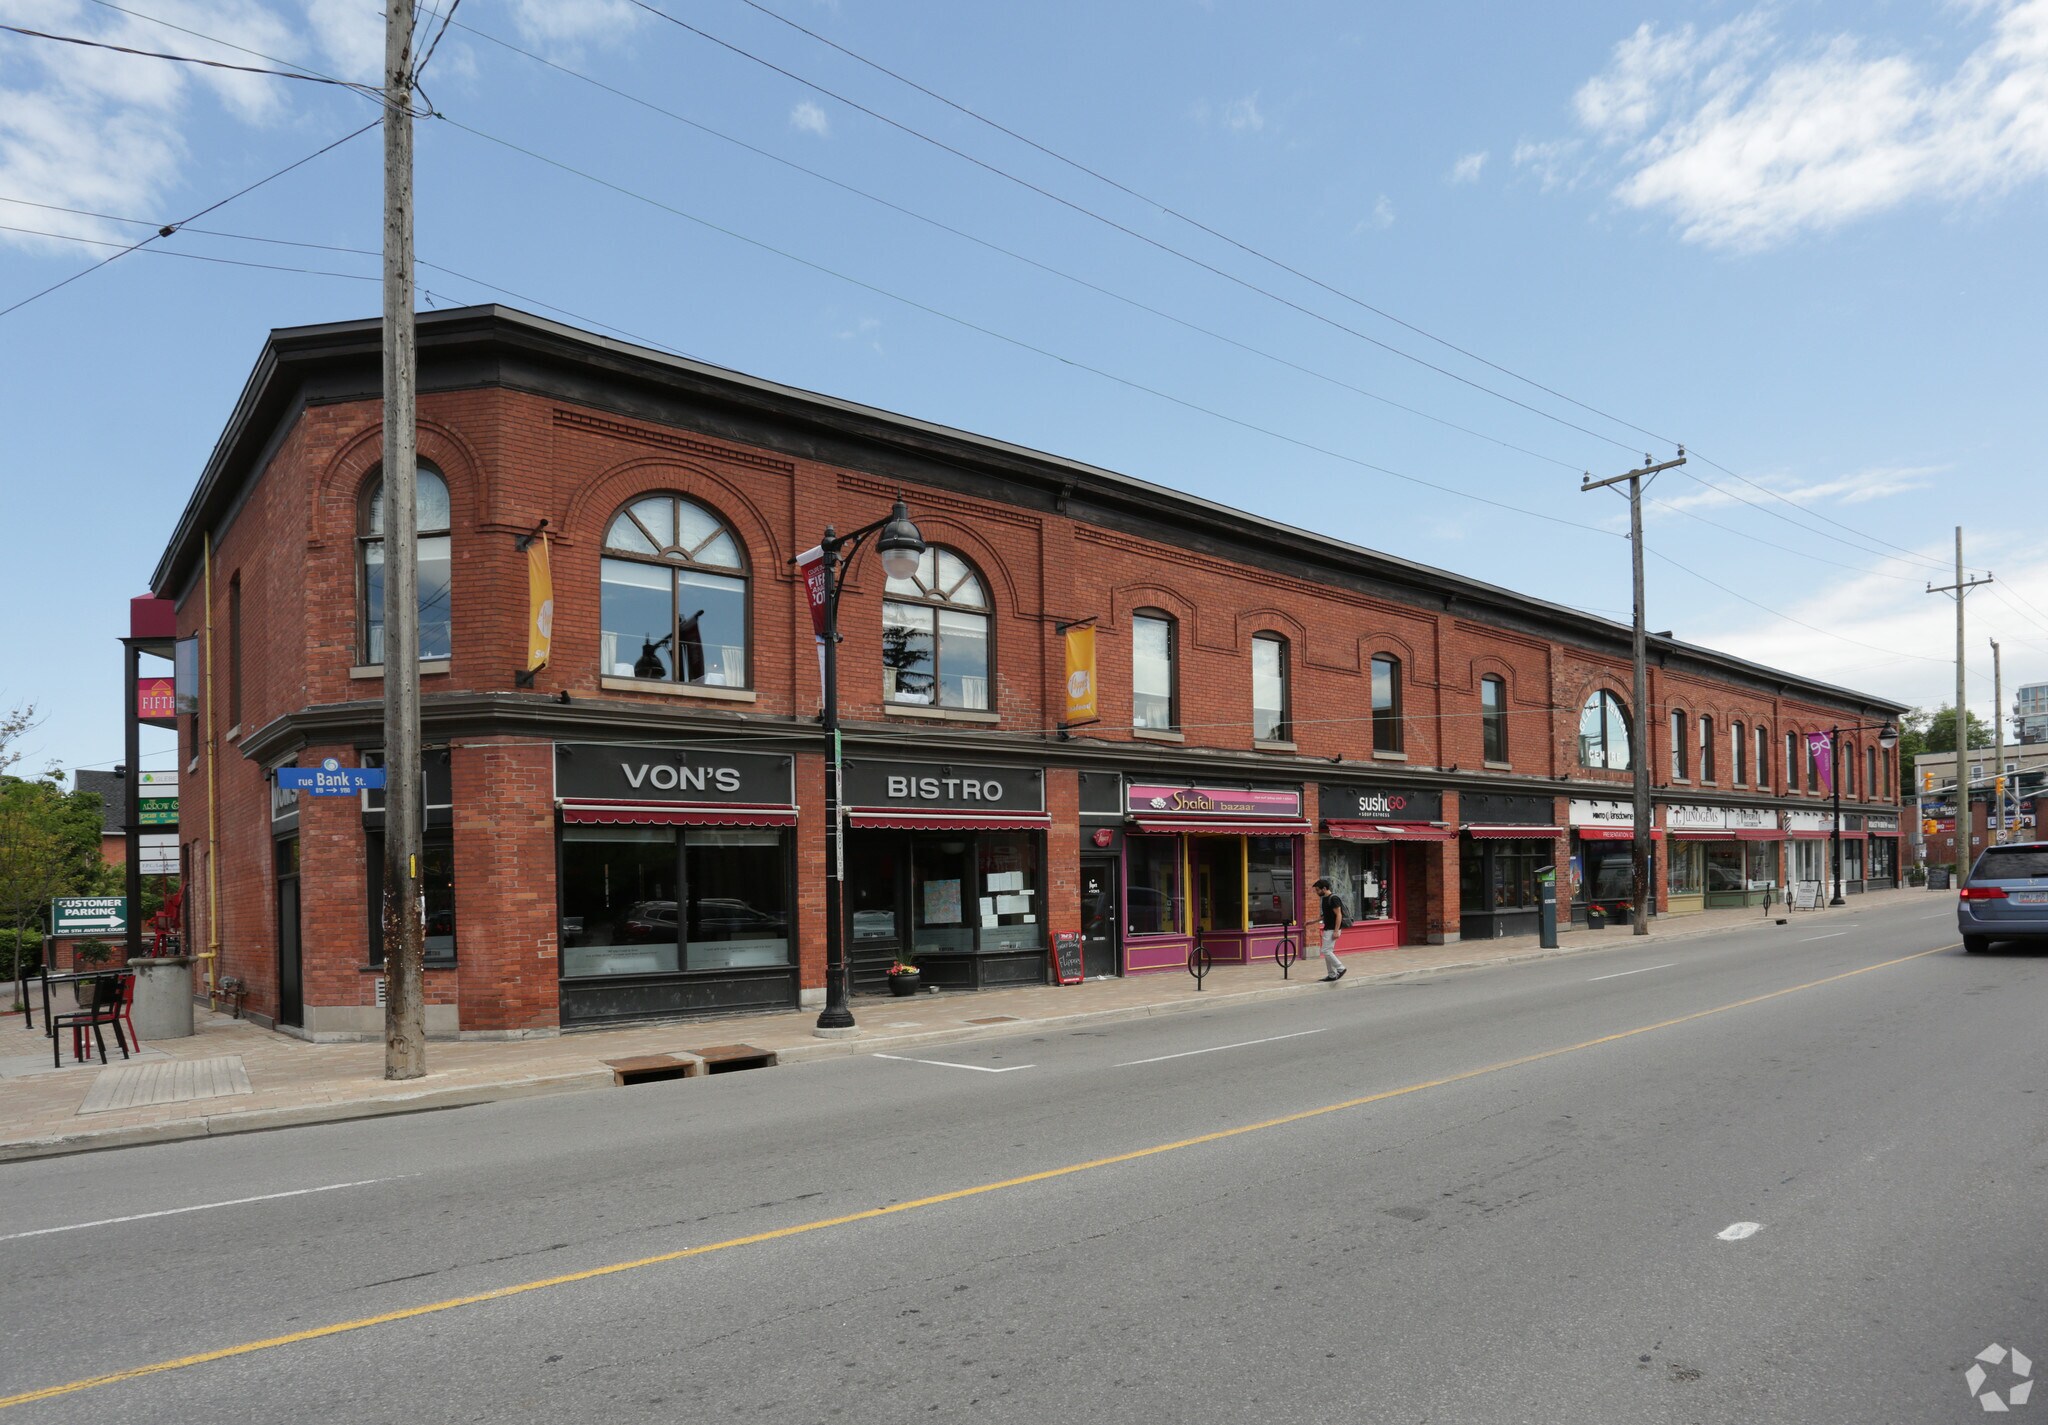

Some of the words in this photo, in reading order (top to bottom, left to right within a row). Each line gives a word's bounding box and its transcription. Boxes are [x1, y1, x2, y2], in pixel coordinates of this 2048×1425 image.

[142, 696, 175, 710] FIFTH
[298, 778, 313, 787] rue
[317, 772, 350, 786] Bank
[355, 777, 366, 786] St.
[621, 763, 740, 792] VON'S
[888, 776, 1003, 801] BISTRO
[1170, 791, 1215, 811] Shafali
[1220, 802, 1255, 811] bazaar
[1683, 809, 1719, 825] JUNOGEMS
[58, 899, 122, 908] CUSTOMER
[65, 908, 116, 916] PARKING
